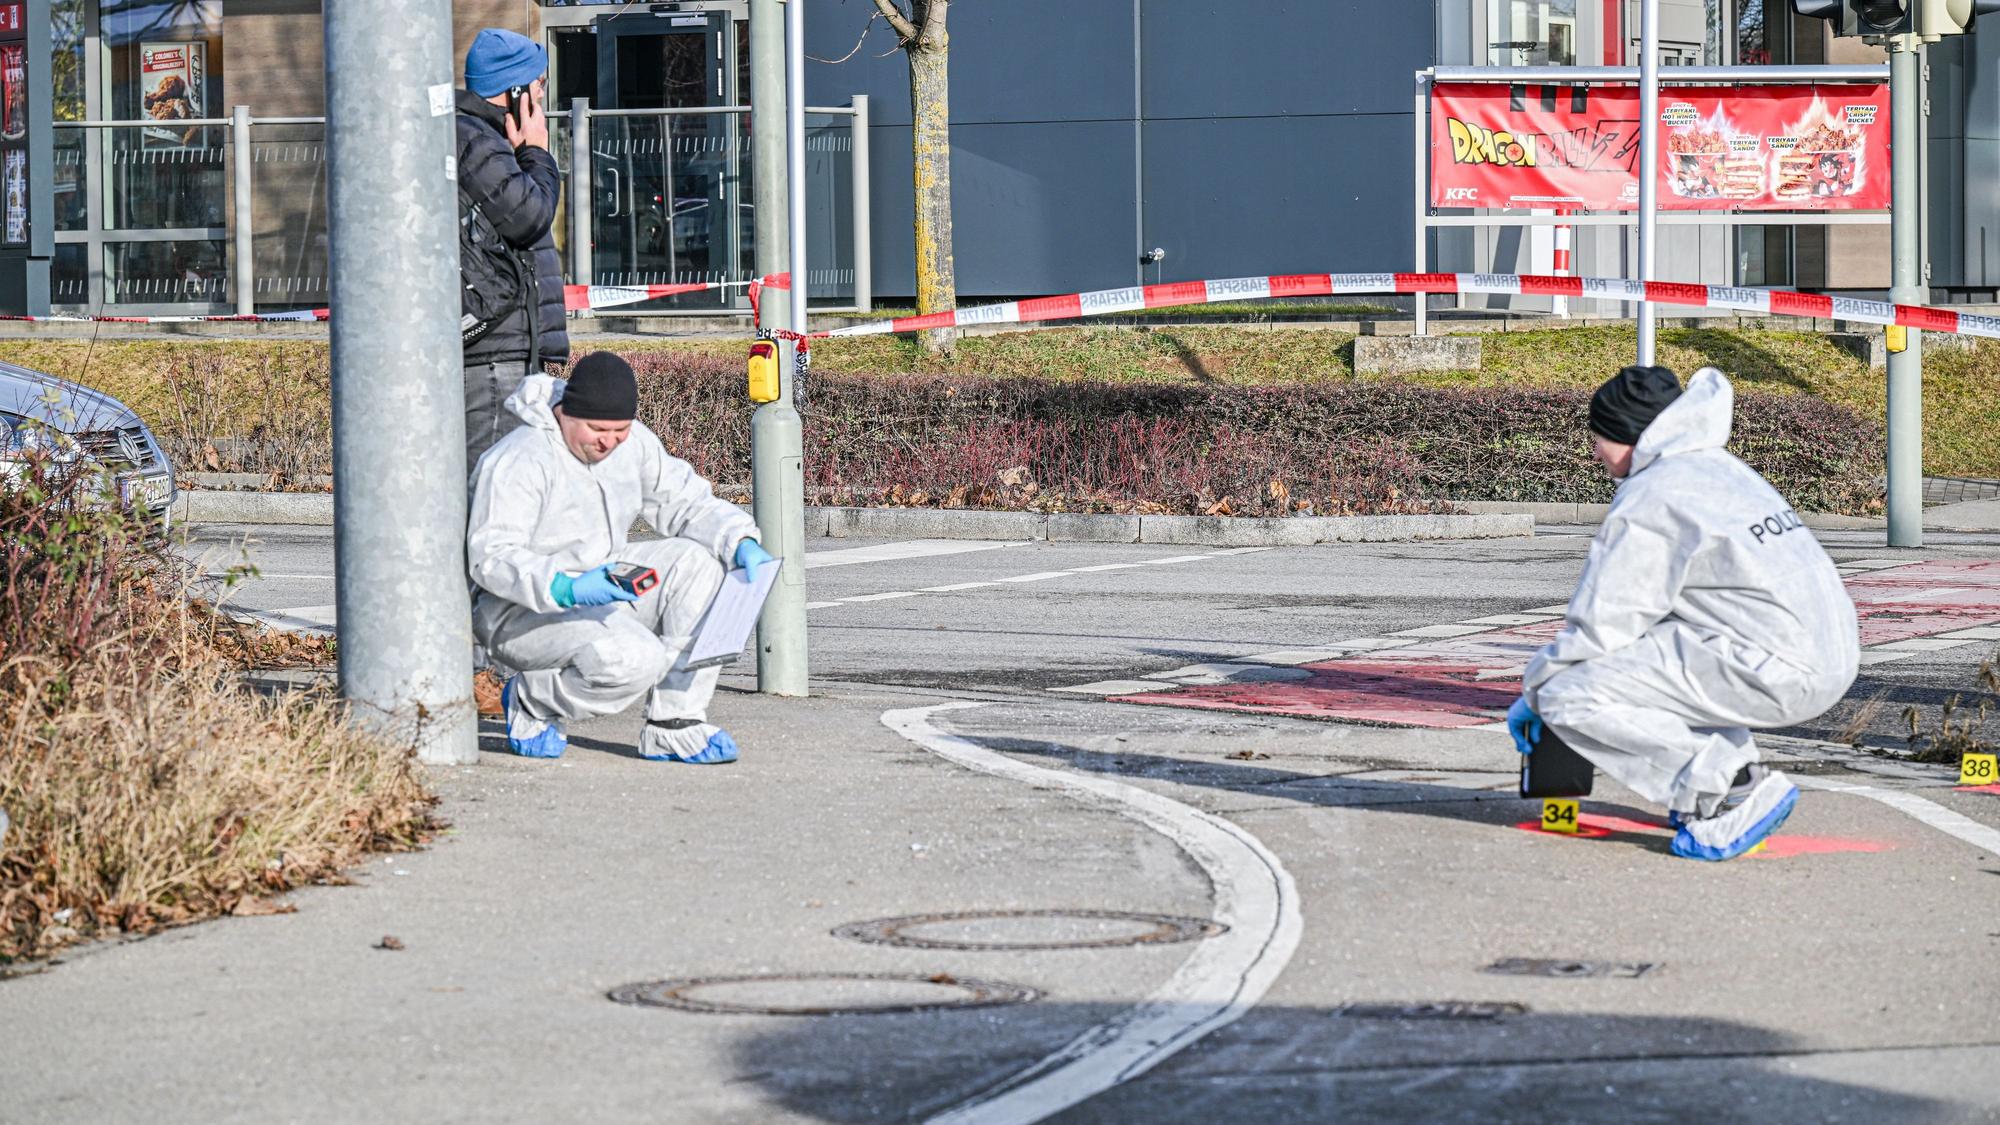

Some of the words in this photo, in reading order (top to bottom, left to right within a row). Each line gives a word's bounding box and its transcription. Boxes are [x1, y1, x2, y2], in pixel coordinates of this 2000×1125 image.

[1446, 187, 1478, 200] KFC
[1964, 759, 1990, 777] 38
[1545, 803, 1575, 824] 34
